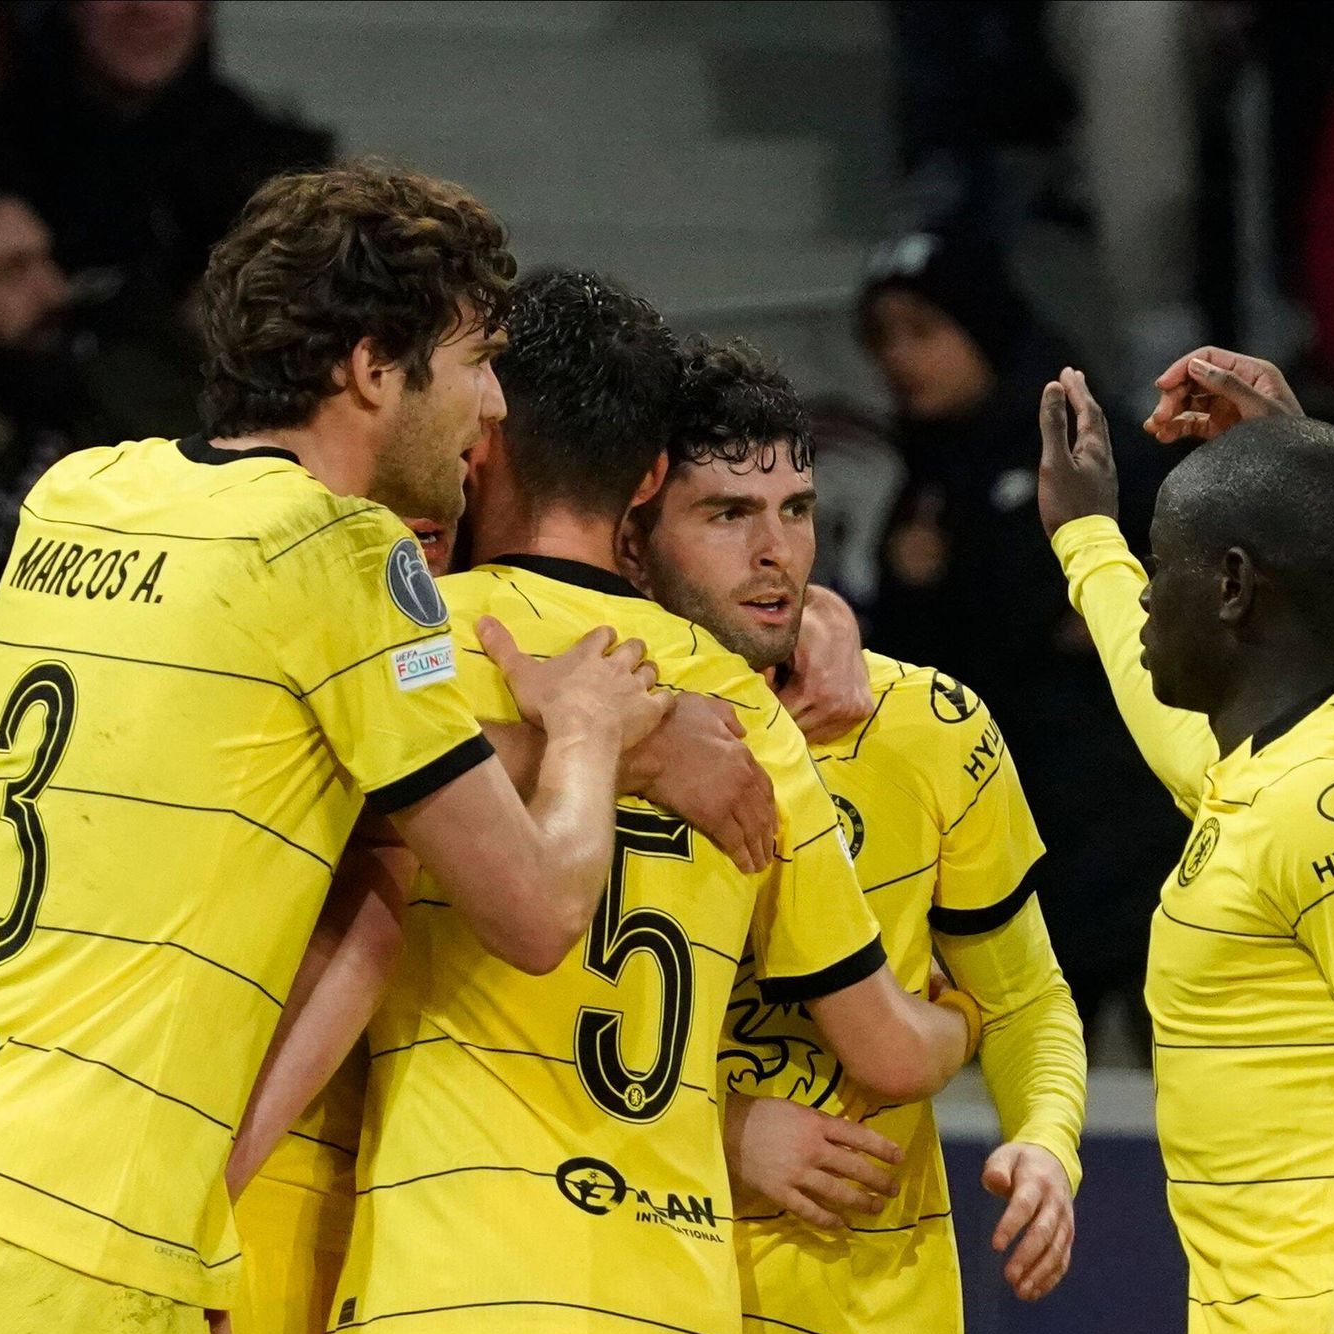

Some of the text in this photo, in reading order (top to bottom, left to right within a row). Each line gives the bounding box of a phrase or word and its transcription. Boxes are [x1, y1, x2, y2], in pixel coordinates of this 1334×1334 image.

[9, 536, 168, 604] MARCOS A.
[397, 651, 452, 677] FOUNDA
[573, 804, 696, 1124] 5
